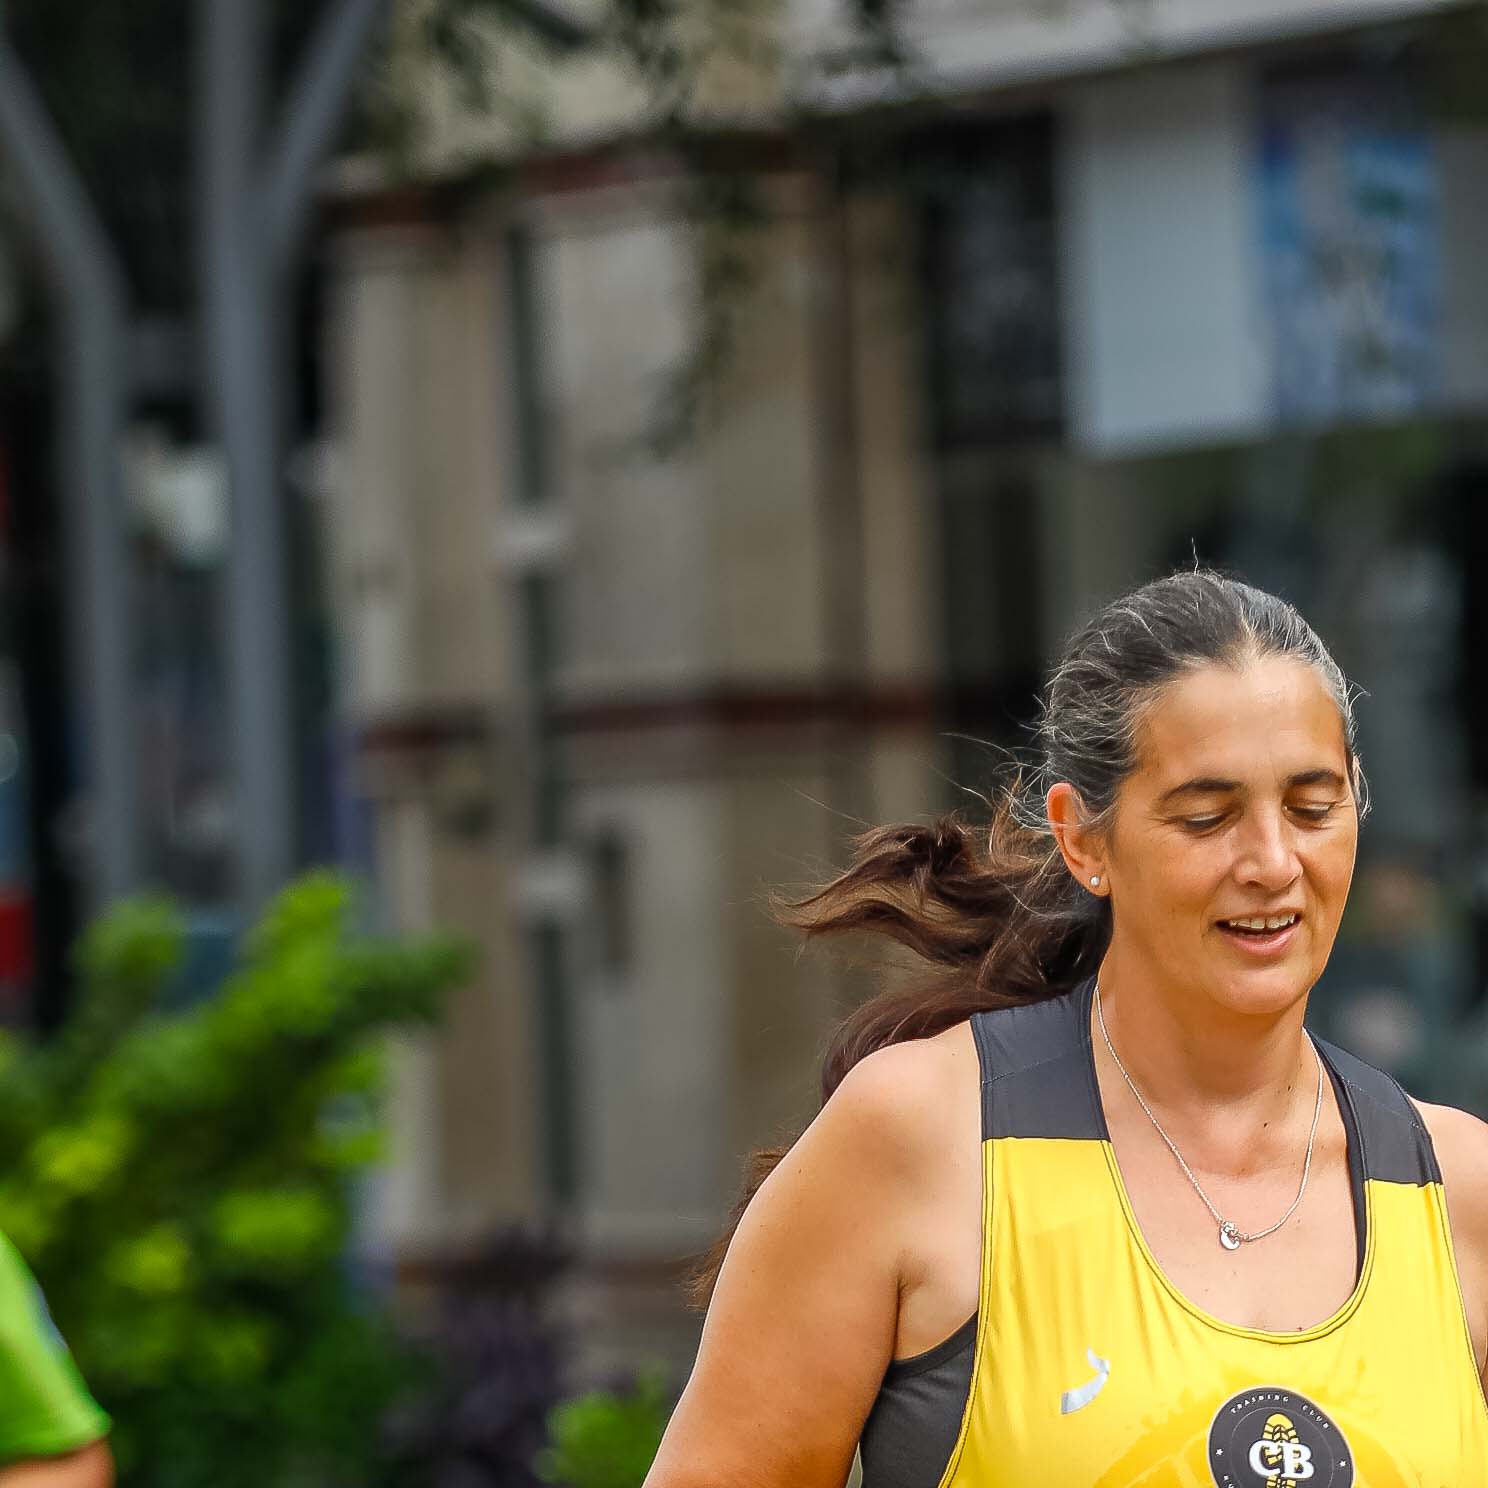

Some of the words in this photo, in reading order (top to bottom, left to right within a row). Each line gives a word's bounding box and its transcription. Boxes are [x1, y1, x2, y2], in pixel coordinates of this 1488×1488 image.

[1230, 1394, 1289, 1414] TRAINING
[1302, 1405, 1330, 1429] CLUB
[1249, 1440, 1315, 1479] CB
